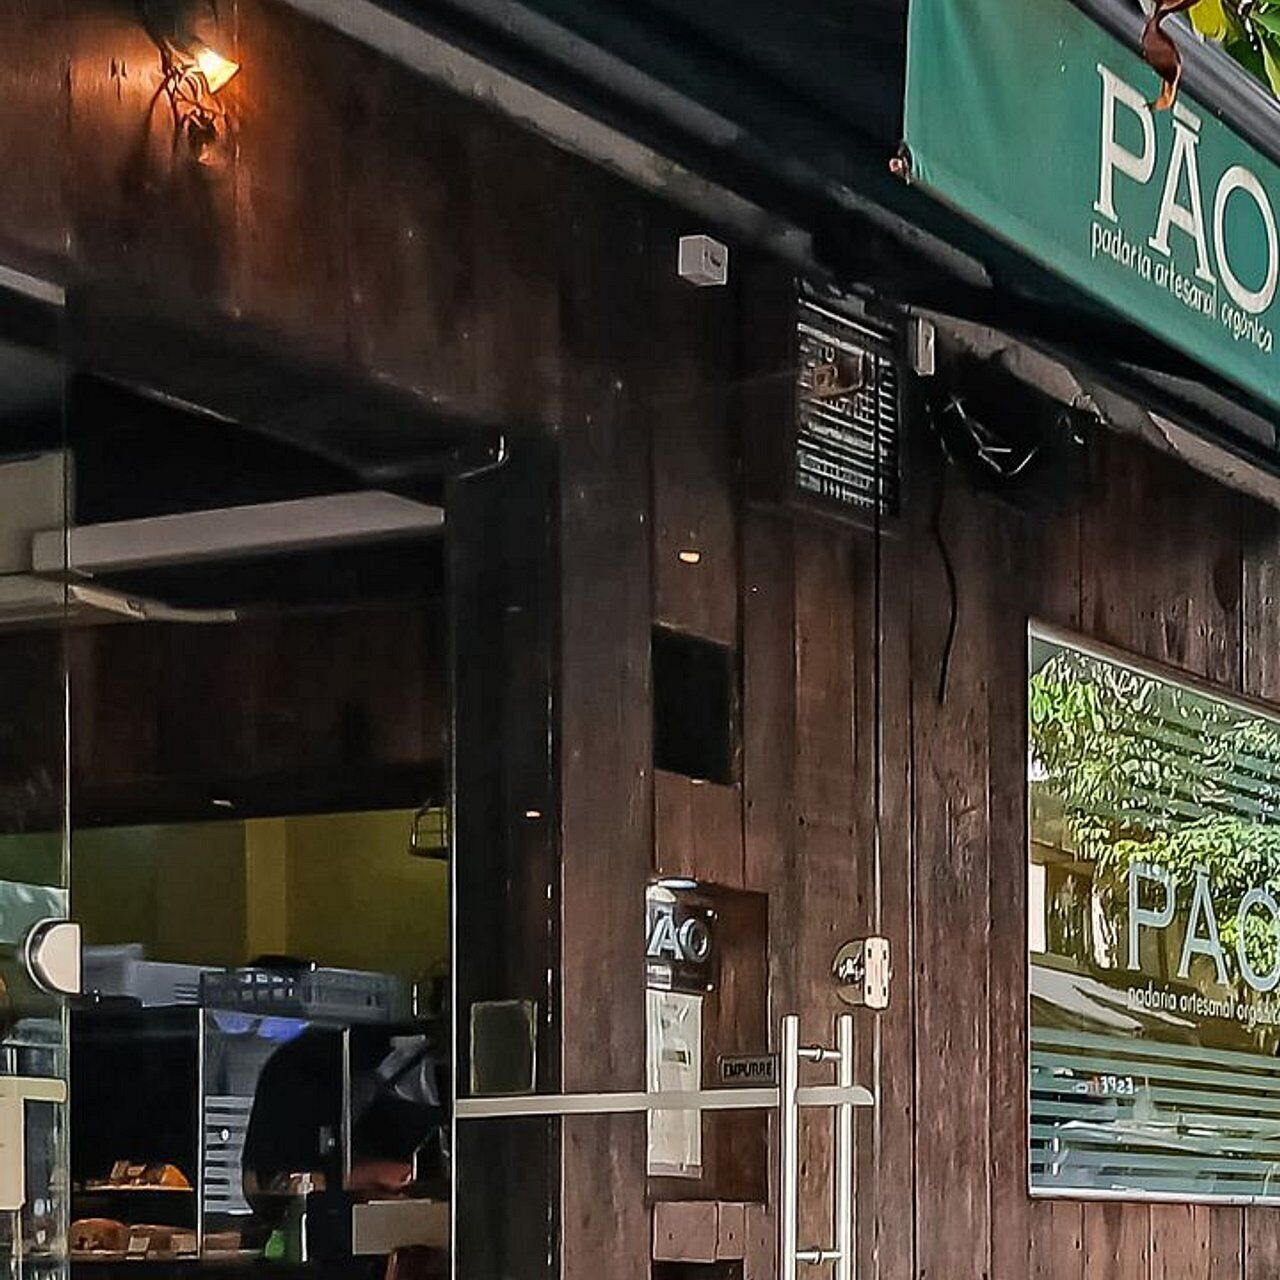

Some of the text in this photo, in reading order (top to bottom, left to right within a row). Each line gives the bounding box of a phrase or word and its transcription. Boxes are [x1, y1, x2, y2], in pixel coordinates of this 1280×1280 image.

[1092, 222, 1153, 280] padaria
[1154, 262, 1218, 319] artesanal
[1127, 980, 1177, 1010] padaria
[1179, 993, 1234, 1019] artesanal
